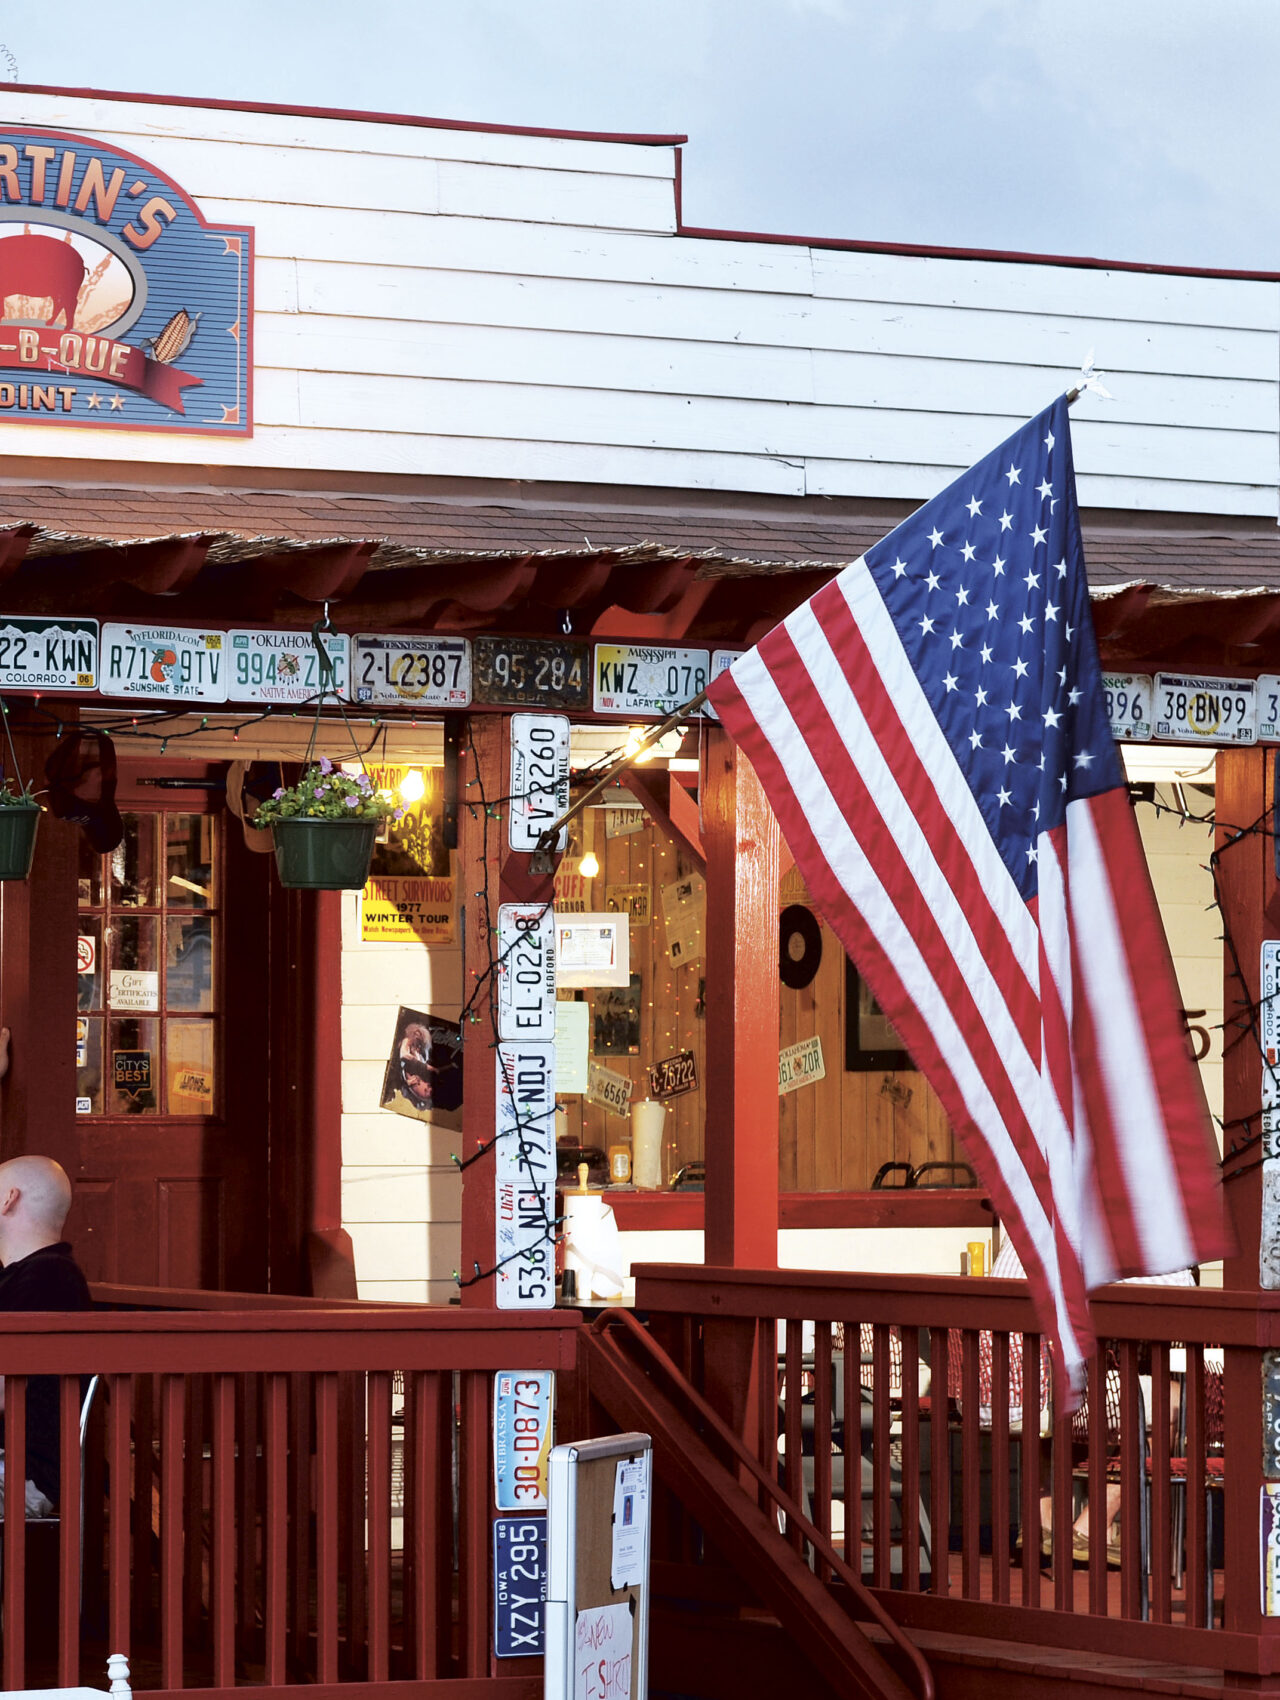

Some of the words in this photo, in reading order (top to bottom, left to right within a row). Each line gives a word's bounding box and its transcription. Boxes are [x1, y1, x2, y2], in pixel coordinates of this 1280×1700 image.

[256, 634, 314, 649] OKLAHOM
[382, 641, 440, 651] TENNESSEE
[627, 648, 677, 664] MISSISSIPPI
[237, 652, 276, 685] 994
[6, 673, 67, 684] COLORADO
[600, 661, 639, 694] KWZ
[1182, 679, 1230, 690] TENNESSEE
[130, 682, 170, 693] SUNSHINE
[260, 687, 289, 699] NATIVE
[603, 697, 615, 708] NOV
[403, 880, 453, 904] SURVIVORS
[554, 875, 585, 899] CUFF
[395, 903, 422, 913] 1977
[365, 914, 414, 924] WINTER
[419, 914, 450, 924] TOUR
[546, 948, 555, 994] BEDFORD
[121, 974, 144, 988] GIFT
[109, 984, 158, 999] CERTIFICATES
[116, 998, 151, 1007] AVAILABLE
[115, 1060, 150, 1071] CITY'S
[115, 1070, 149, 1082] BEST
[518, 1054, 547, 1103] NDJ
[497, 1402, 508, 1475] NEBRASKA
[499, 1523, 507, 1539] 86
[510, 1524, 540, 1582] 295
[498, 1570, 508, 1606] IOWA
[510, 1591, 540, 1648] XZY
